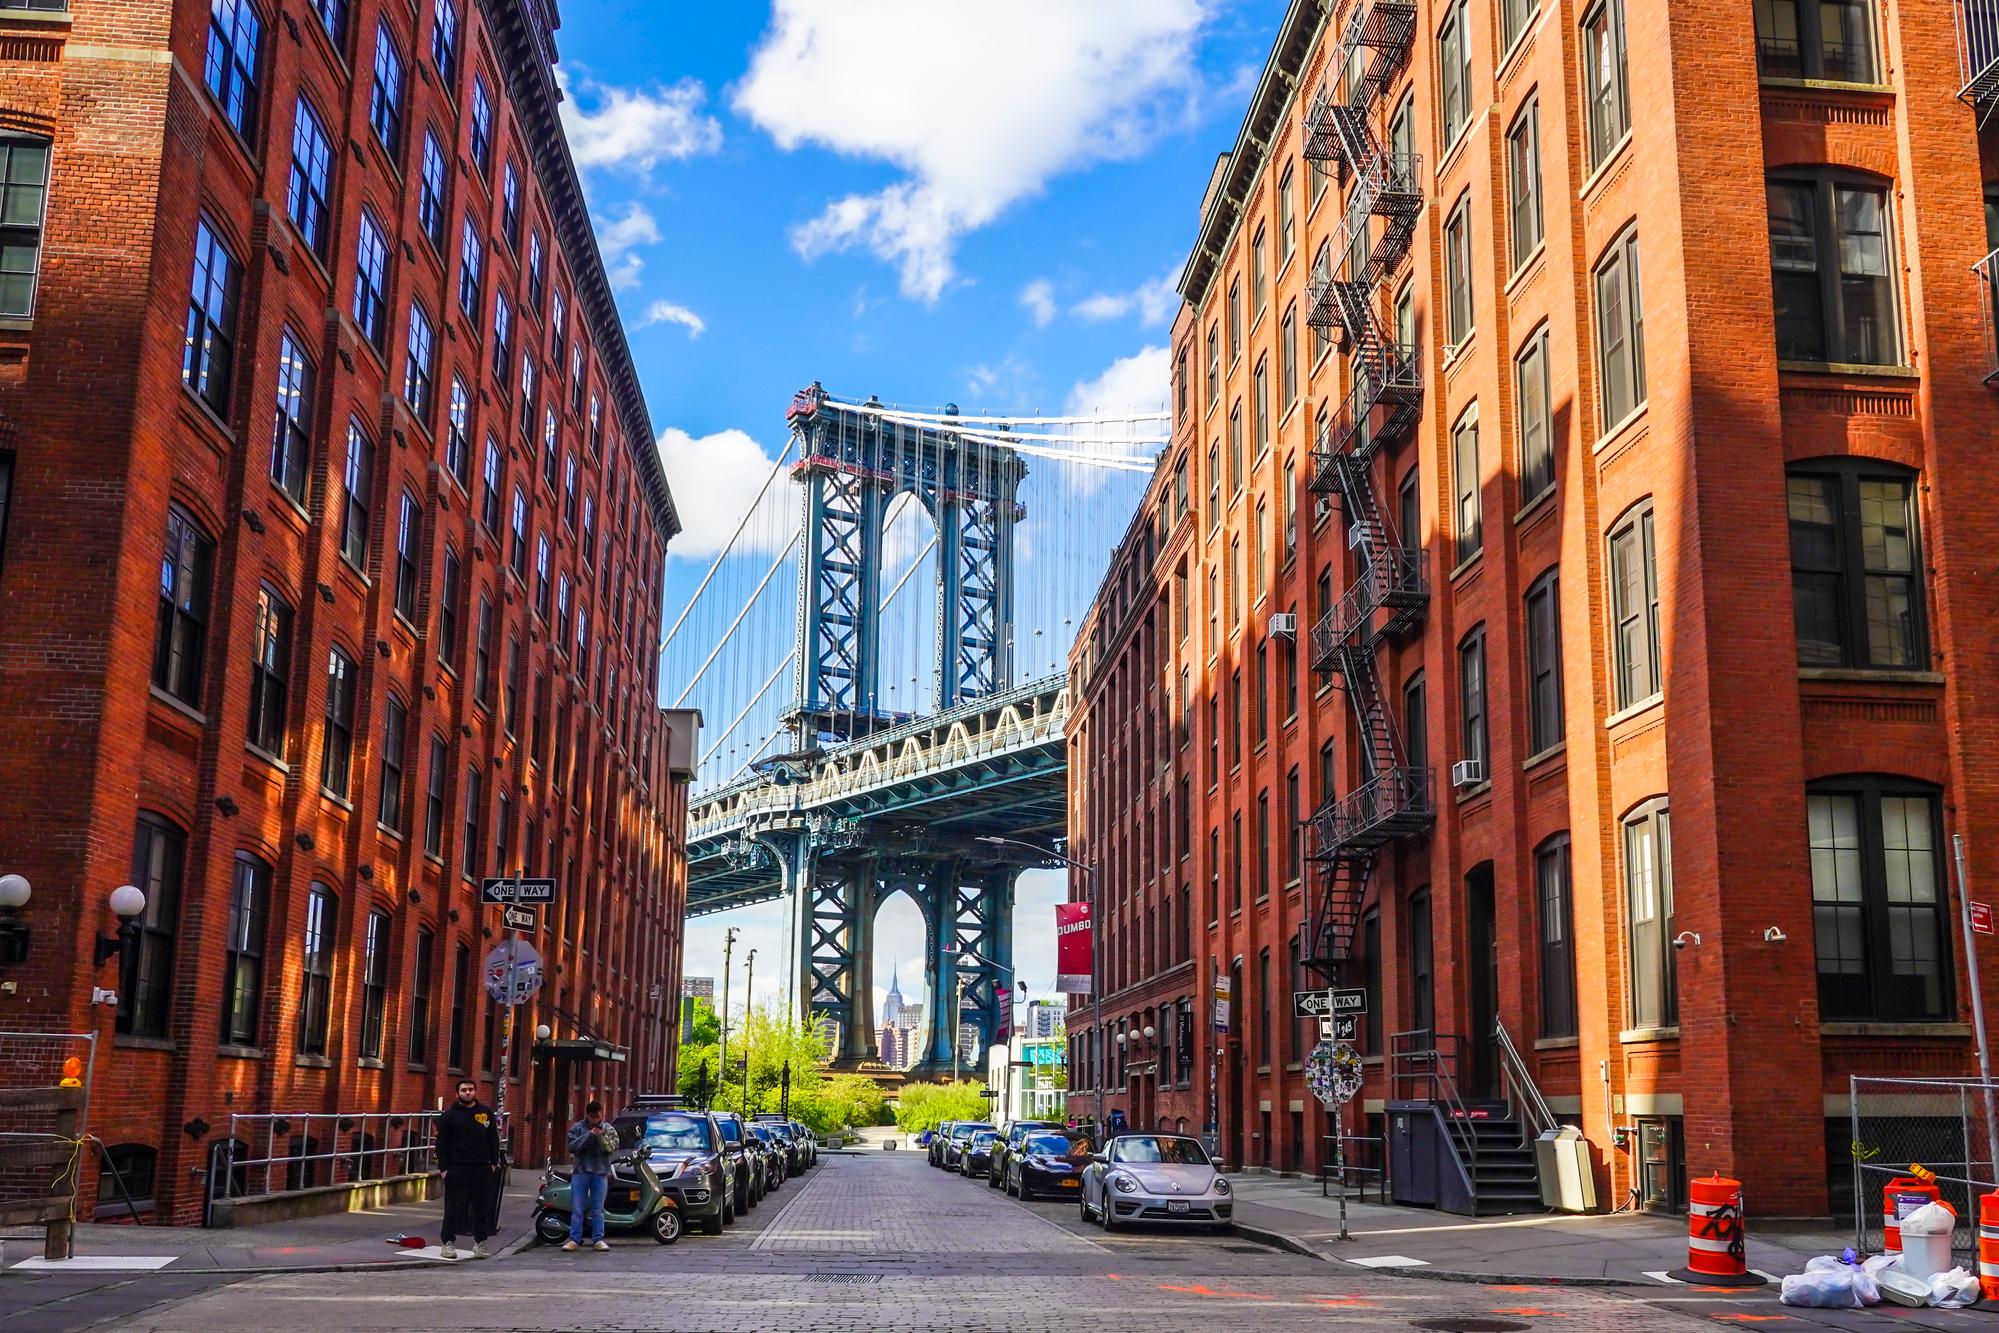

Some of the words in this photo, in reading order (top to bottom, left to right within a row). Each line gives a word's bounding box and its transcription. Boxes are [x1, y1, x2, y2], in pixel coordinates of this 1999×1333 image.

[493, 886, 514, 896] ONE
[523, 886, 546, 896] WAY
[509, 911, 518, 922] ONE
[521, 914, 532, 924] WAY
[1057, 919, 1091, 936] DUMBO
[1306, 999, 1327, 1009] ONE
[1335, 996, 1357, 1007] WAY
